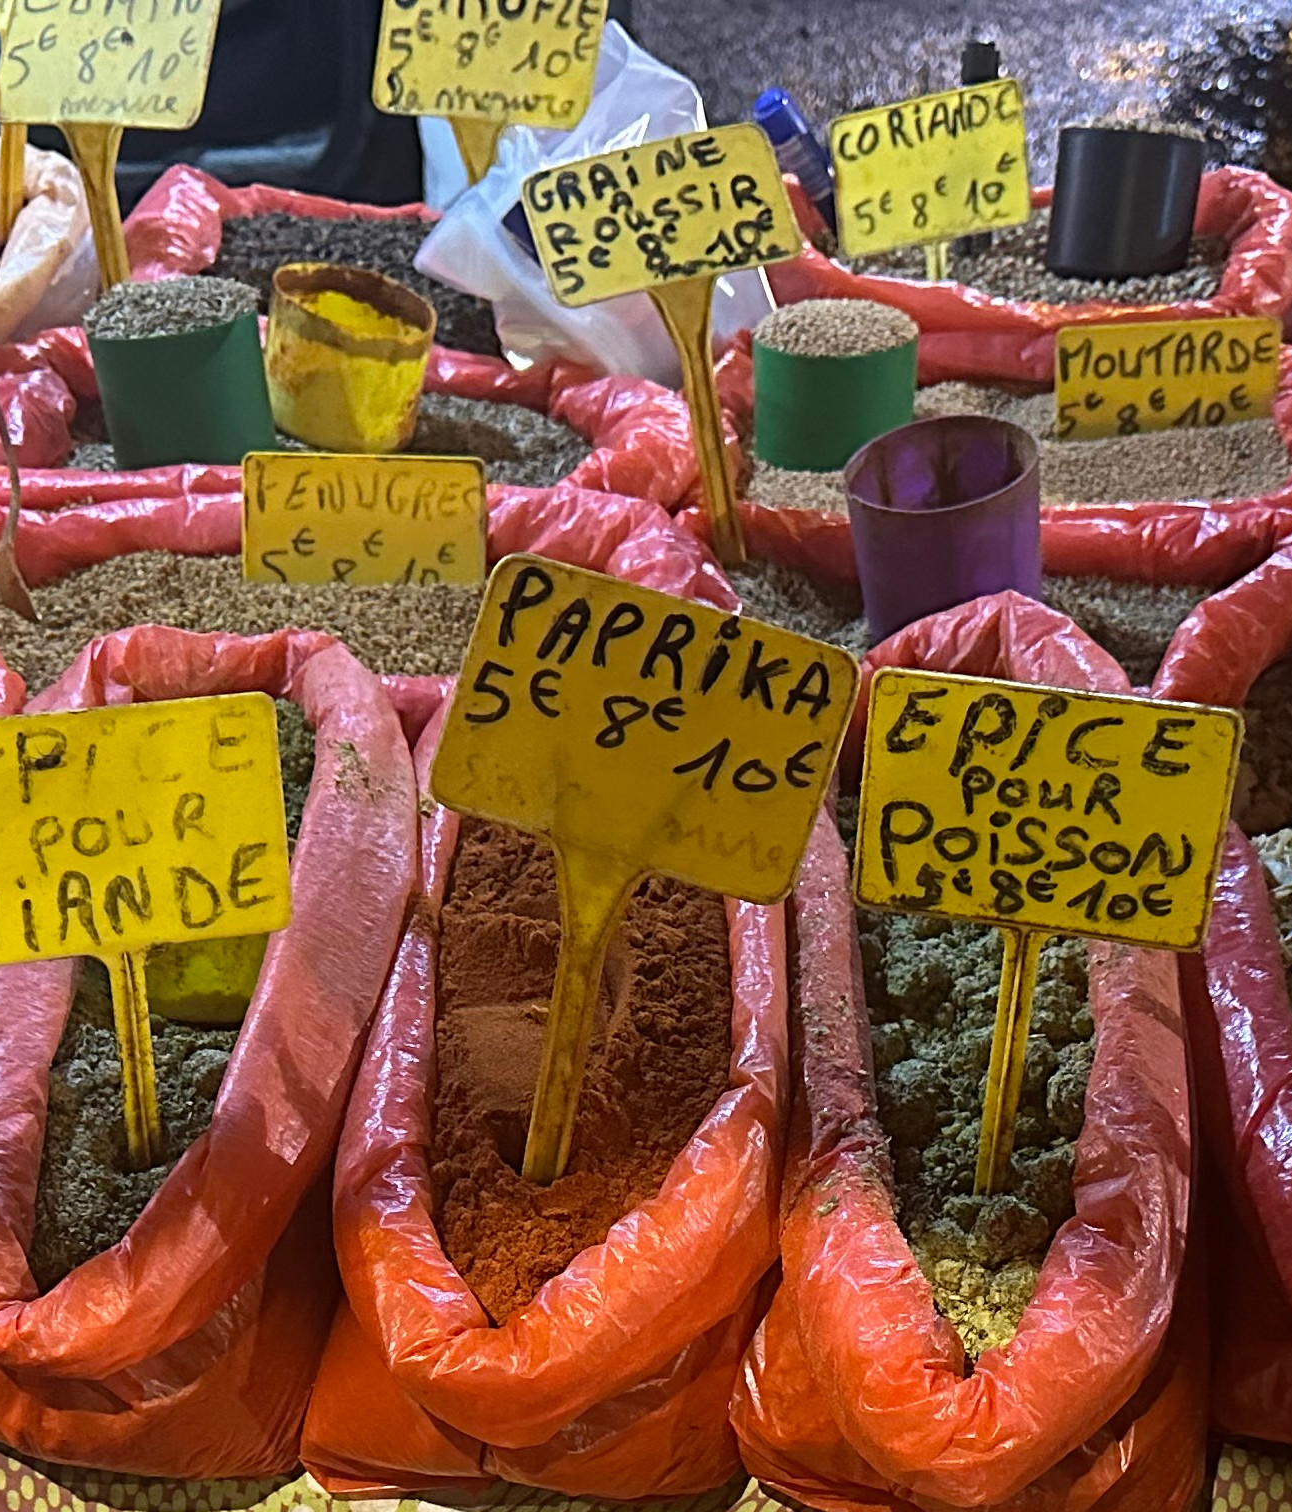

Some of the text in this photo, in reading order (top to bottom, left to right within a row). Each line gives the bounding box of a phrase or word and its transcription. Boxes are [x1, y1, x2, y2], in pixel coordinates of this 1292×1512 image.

[1059, 330, 1274, 382] MOUTARDE
[464, 660, 823, 793] 5€ 8€ 10€
[29, 792, 215, 877] POUR
